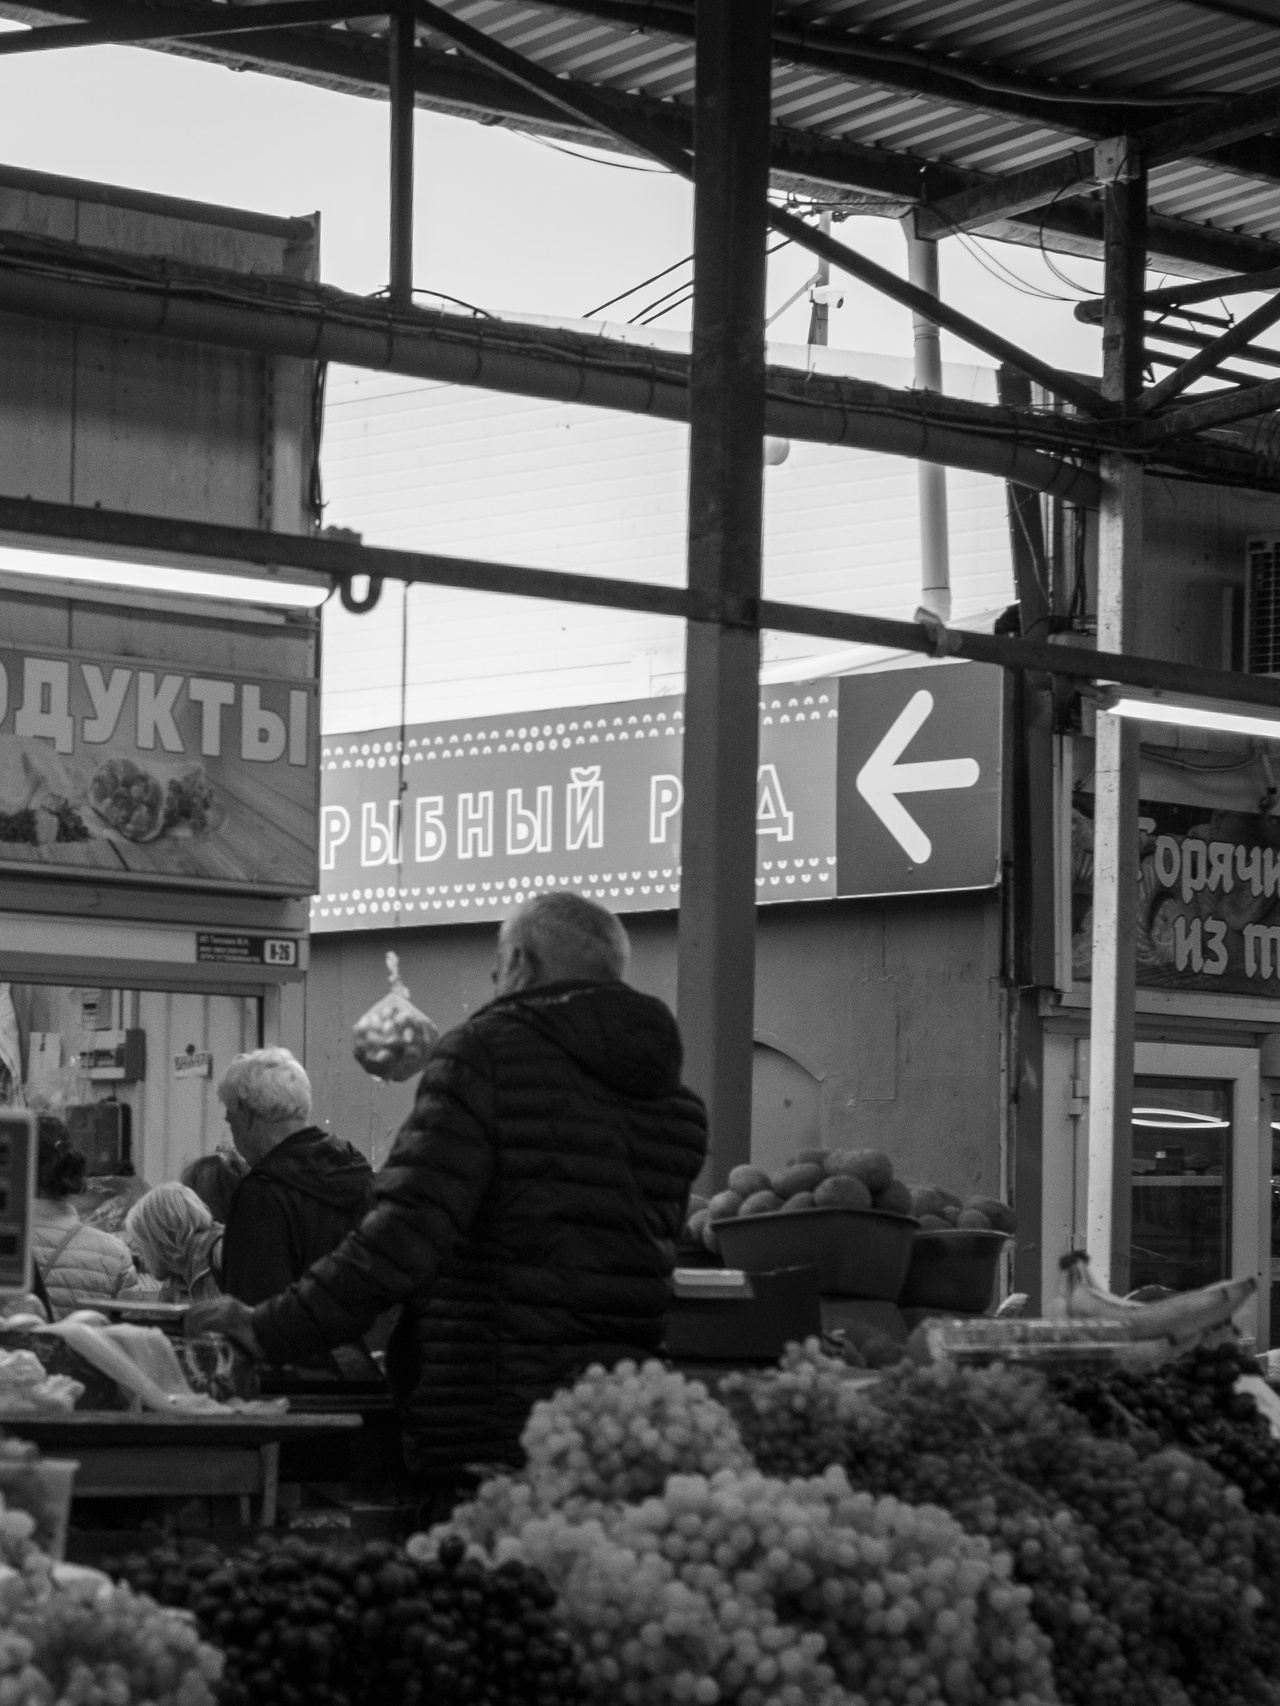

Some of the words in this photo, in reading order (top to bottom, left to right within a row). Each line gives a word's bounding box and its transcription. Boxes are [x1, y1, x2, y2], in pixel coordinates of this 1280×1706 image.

[320, 765, 605, 870] РЫБНЫЙ
[649, 763, 795, 845] РД
[1138, 816, 1280, 904] орячи
